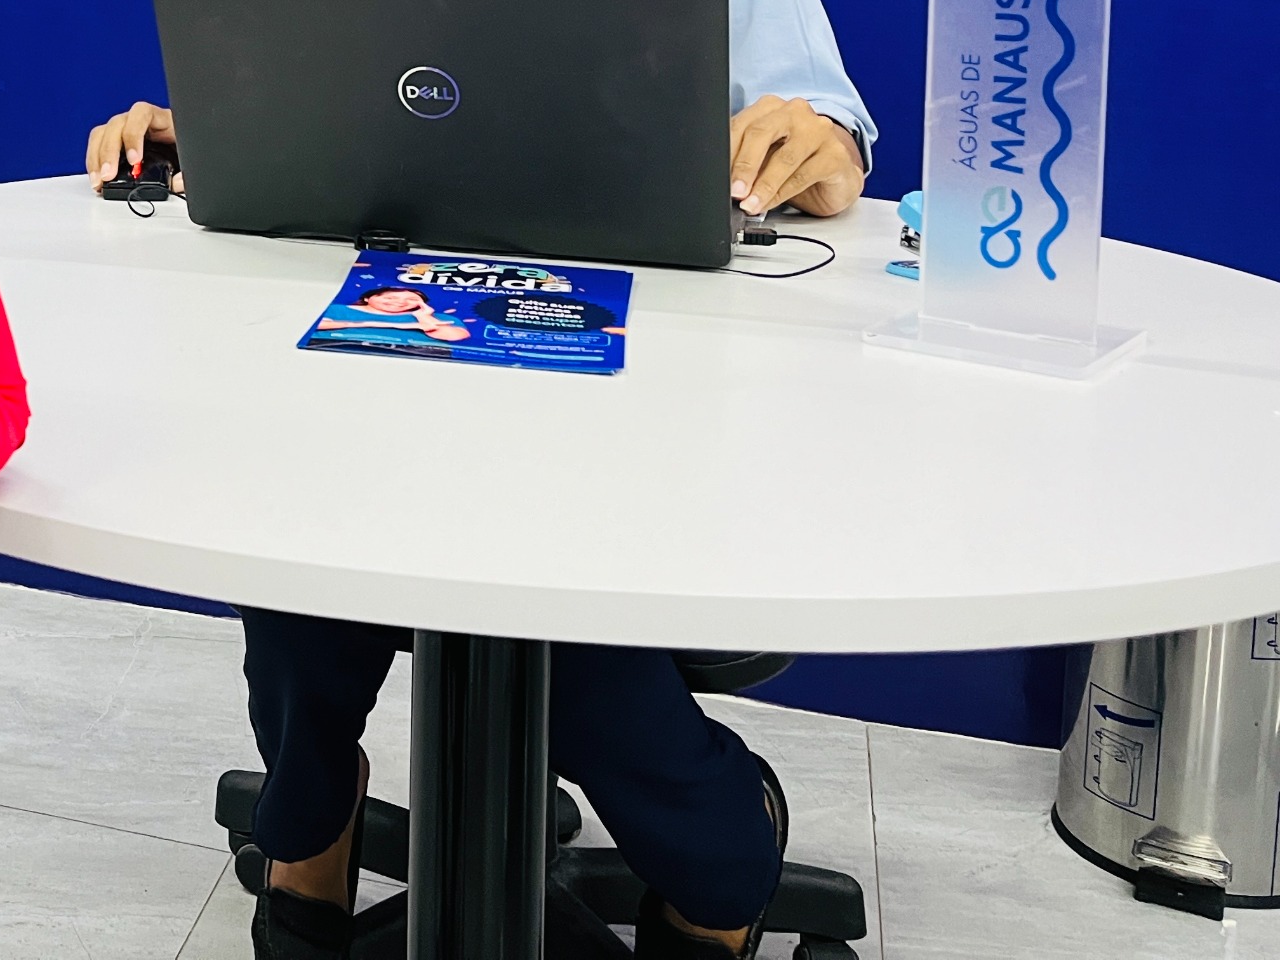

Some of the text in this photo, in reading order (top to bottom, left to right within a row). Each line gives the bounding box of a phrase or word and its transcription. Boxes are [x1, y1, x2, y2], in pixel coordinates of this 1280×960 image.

[405, 85, 454, 100] DELL
[952, 54, 981, 171] ÁGUAS DE
[430, 262, 549, 280] zera
[397, 271, 573, 293] dívida
